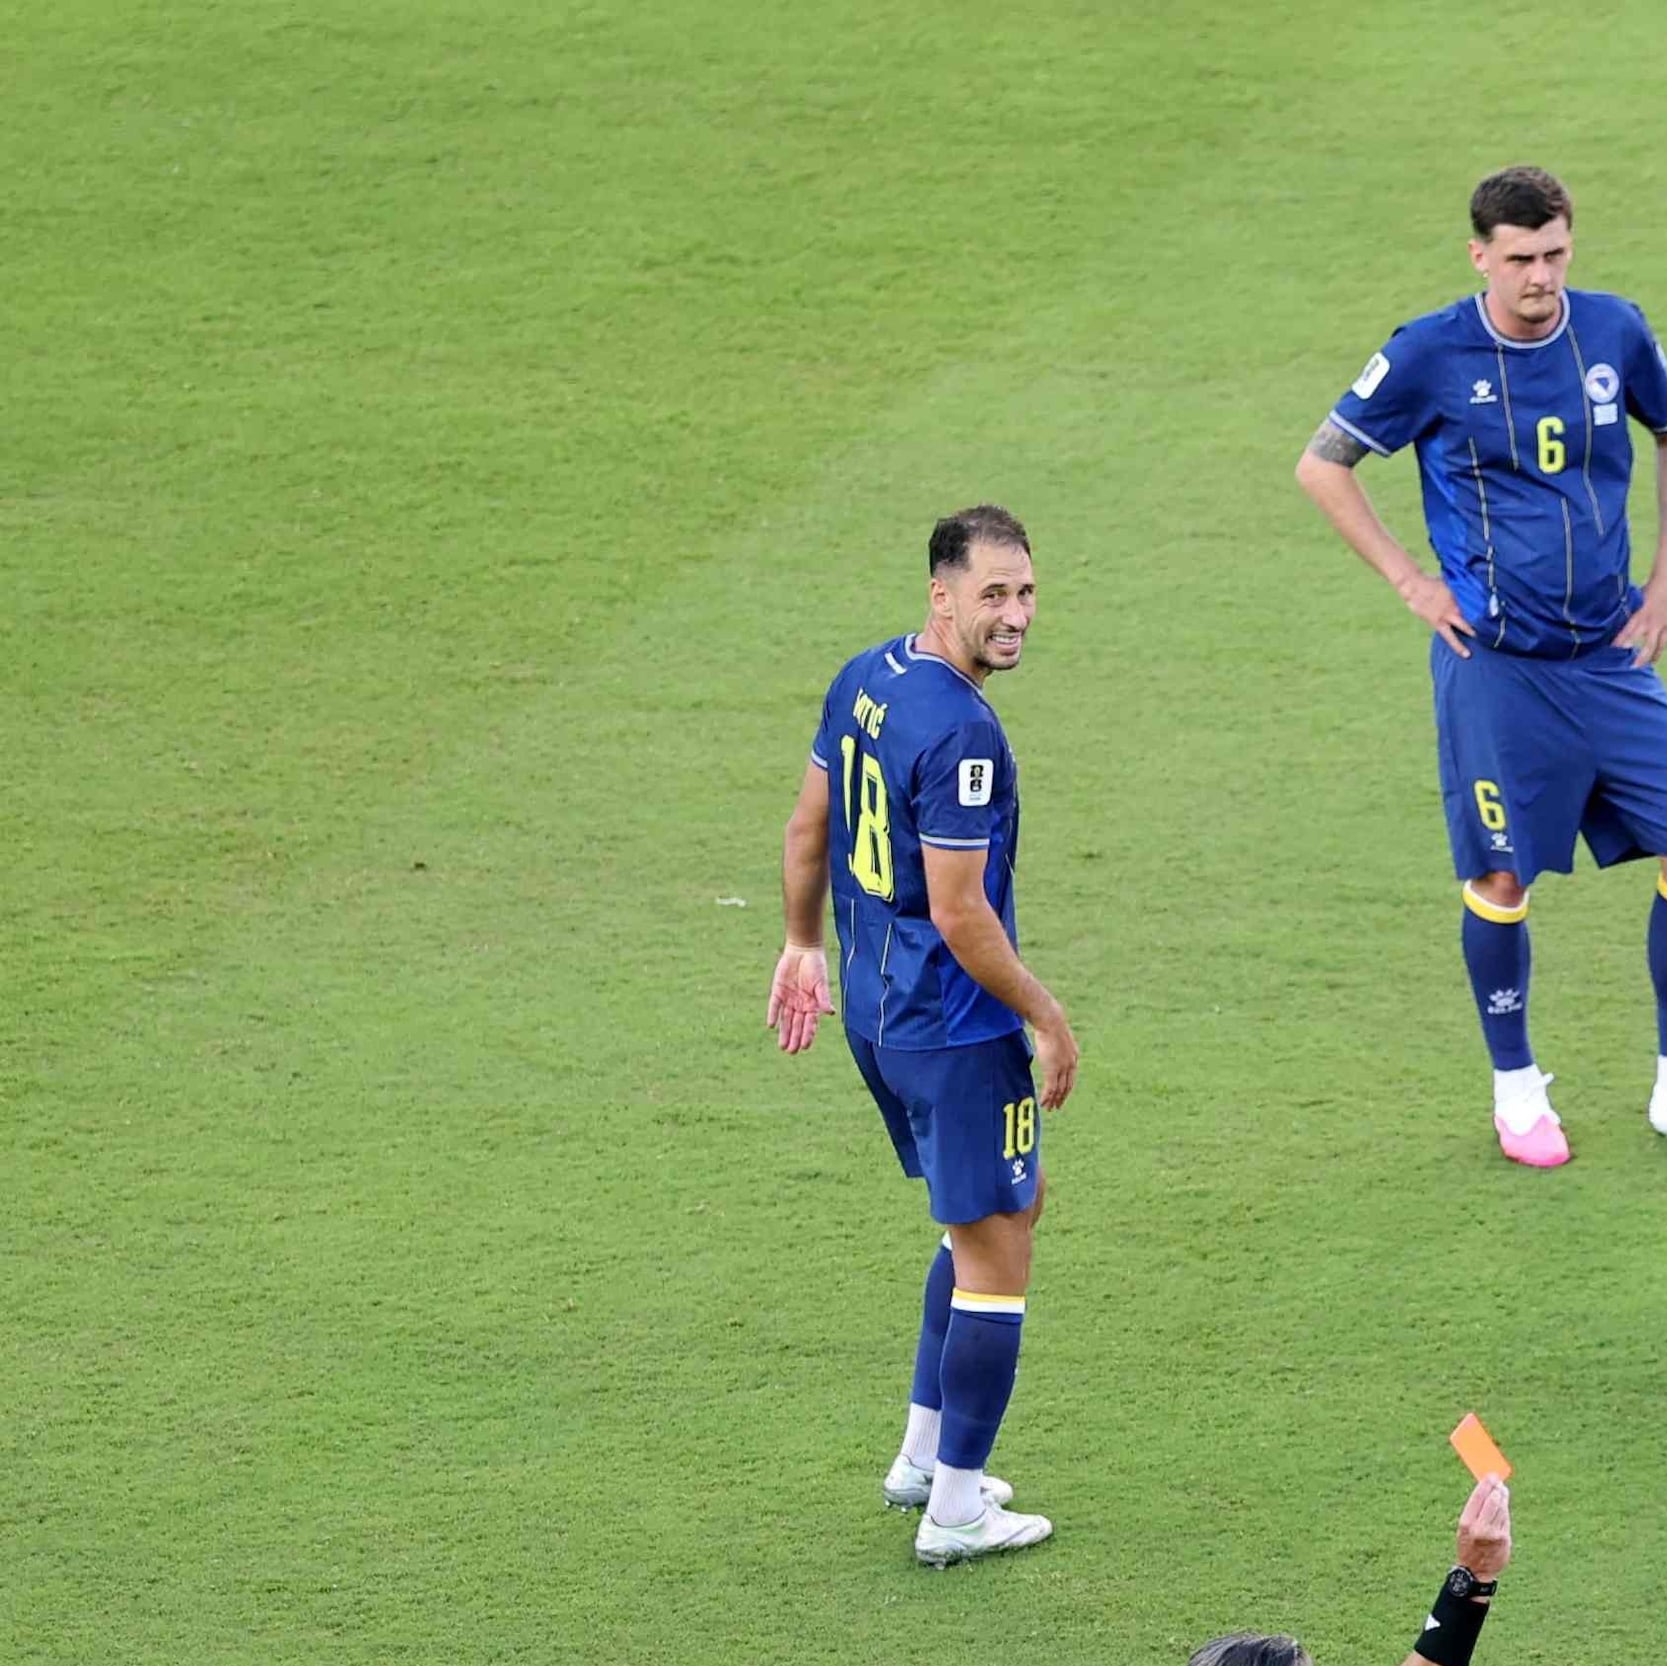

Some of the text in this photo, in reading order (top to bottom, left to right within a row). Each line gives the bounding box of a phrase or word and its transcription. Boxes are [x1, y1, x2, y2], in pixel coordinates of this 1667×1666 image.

[1537, 416, 1565, 473] 6
[841, 735, 895, 902] 18
[1474, 779, 1506, 831] 6
[1003, 1097, 1035, 1160] 18
